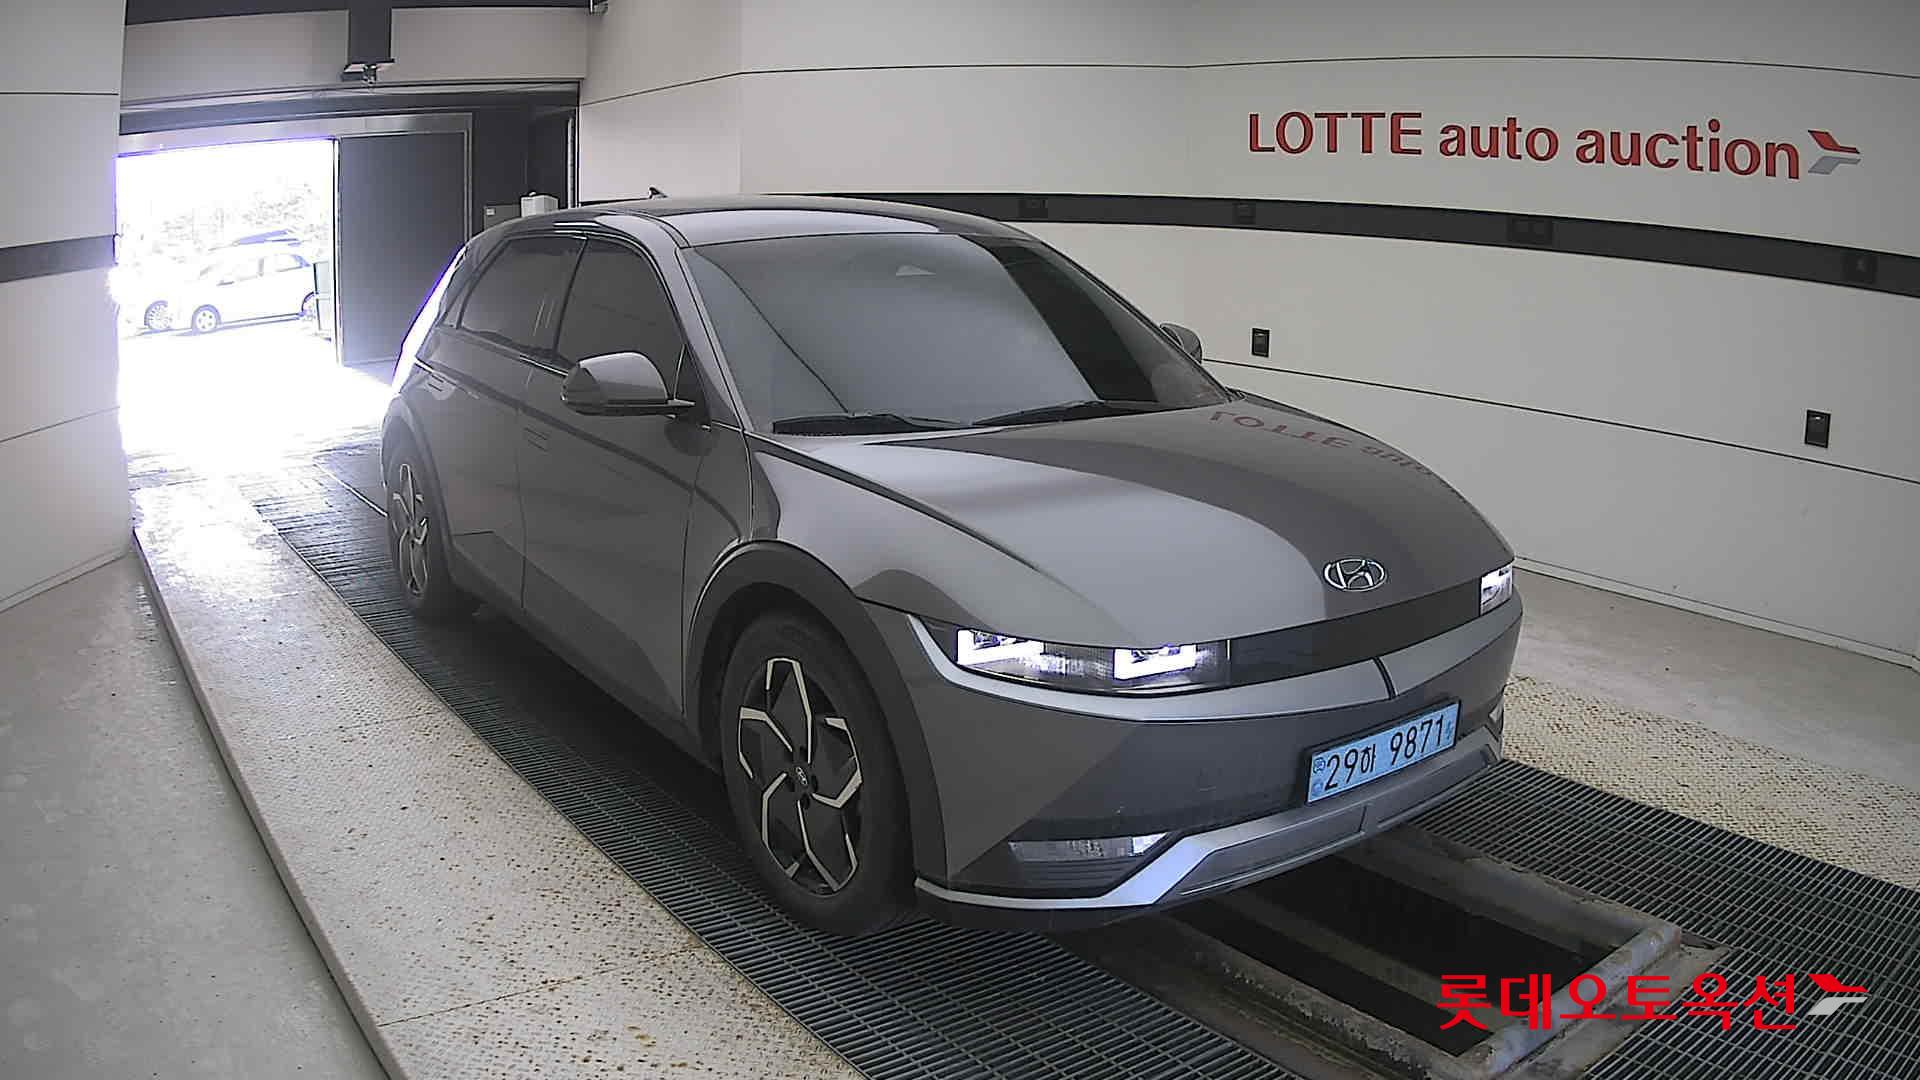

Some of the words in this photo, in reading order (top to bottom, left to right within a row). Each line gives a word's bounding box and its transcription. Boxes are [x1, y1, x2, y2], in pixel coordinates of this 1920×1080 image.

[1249, 112, 1423, 154] LOTTE
[1439, 116, 1560, 161] auto
[1576, 118, 1800, 180] auction
[1324, 744, 1377, 790] 29하
[1390, 714, 1444, 764] 9871
